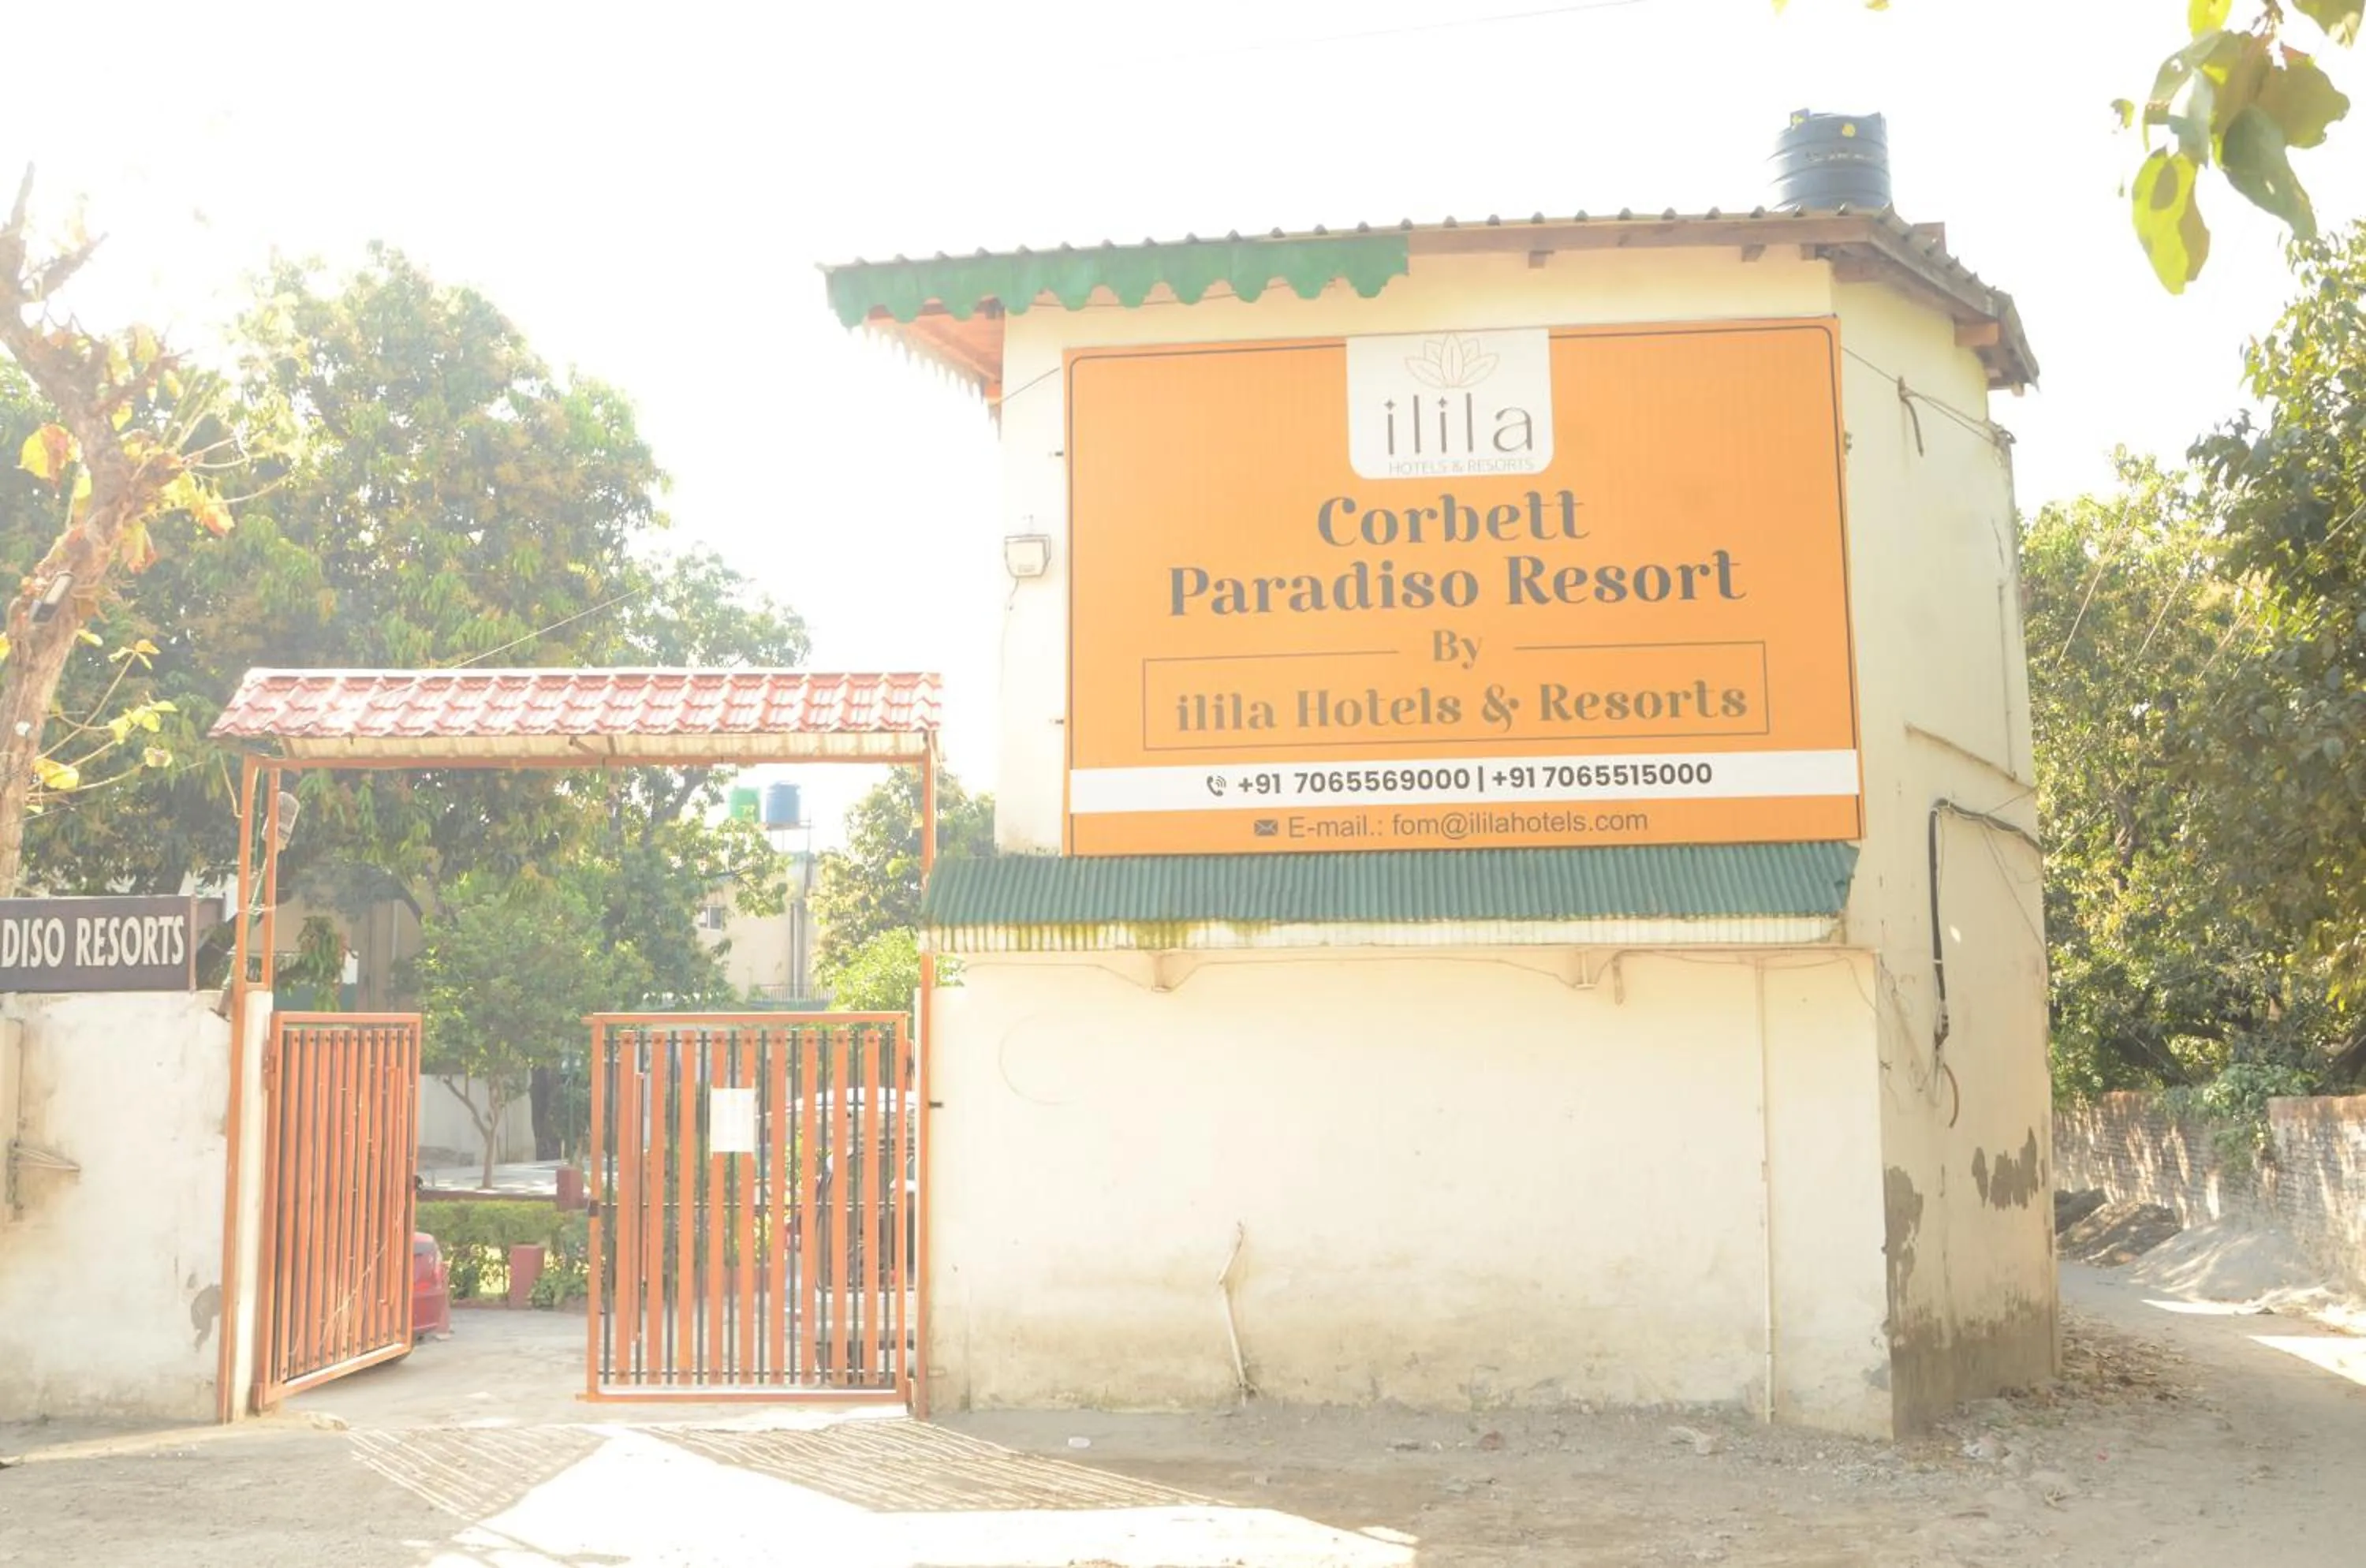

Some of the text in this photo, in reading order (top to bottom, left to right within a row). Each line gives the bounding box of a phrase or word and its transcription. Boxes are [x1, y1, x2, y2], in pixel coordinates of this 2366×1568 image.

[1384, 392, 1533, 456] ilila
[1389, 457, 1536, 476] HOTELS & RESORTS
[1317, 490, 1591, 547] Corbett
[1168, 549, 1748, 617] Paradiso Resort
[1432, 629, 1483, 670] By
[1175, 679, 1748, 734] ilila Hotels & Resorts
[1238, 773, 1282, 794] +91
[1294, 767, 1471, 793] 7065569000
[1491, 766, 1536, 788] +91
[1542, 763, 1713, 788] 7065515000
[1288, 810, 1649, 841] E-mail.: fom@ililahotels.com
[1, 915, 185, 968] DISO RESORTS
